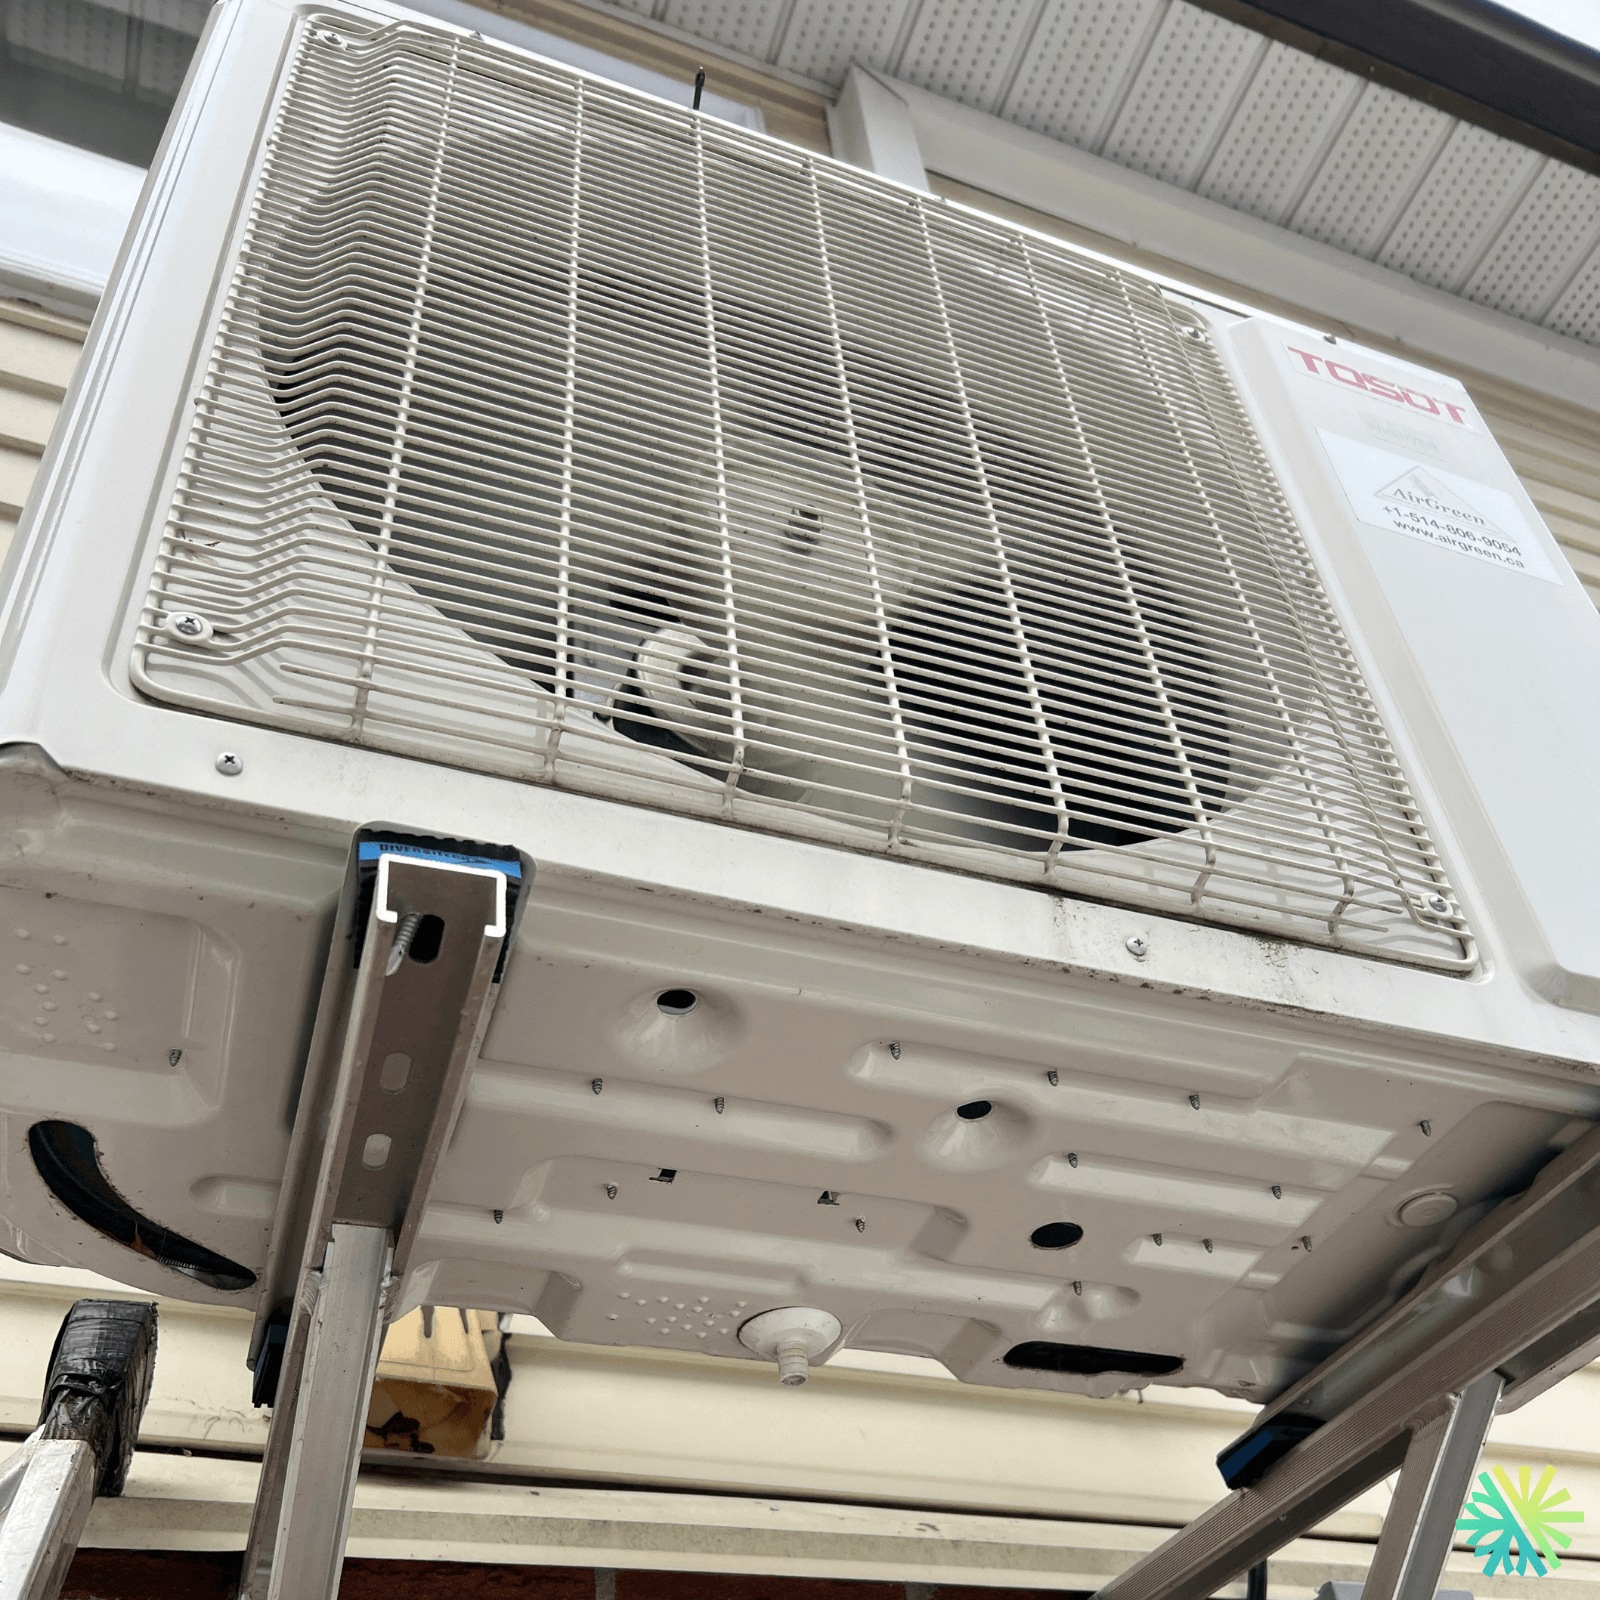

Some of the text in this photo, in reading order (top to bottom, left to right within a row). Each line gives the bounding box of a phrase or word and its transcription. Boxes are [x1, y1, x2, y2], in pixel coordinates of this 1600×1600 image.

[1287, 346, 1466, 424] TOSOT
[1383, 505, 1522, 556] +1-514-806-9054
[1393, 488, 1487, 526] AirGreen
[1393, 520, 1525, 568] www.airgreen.ca
